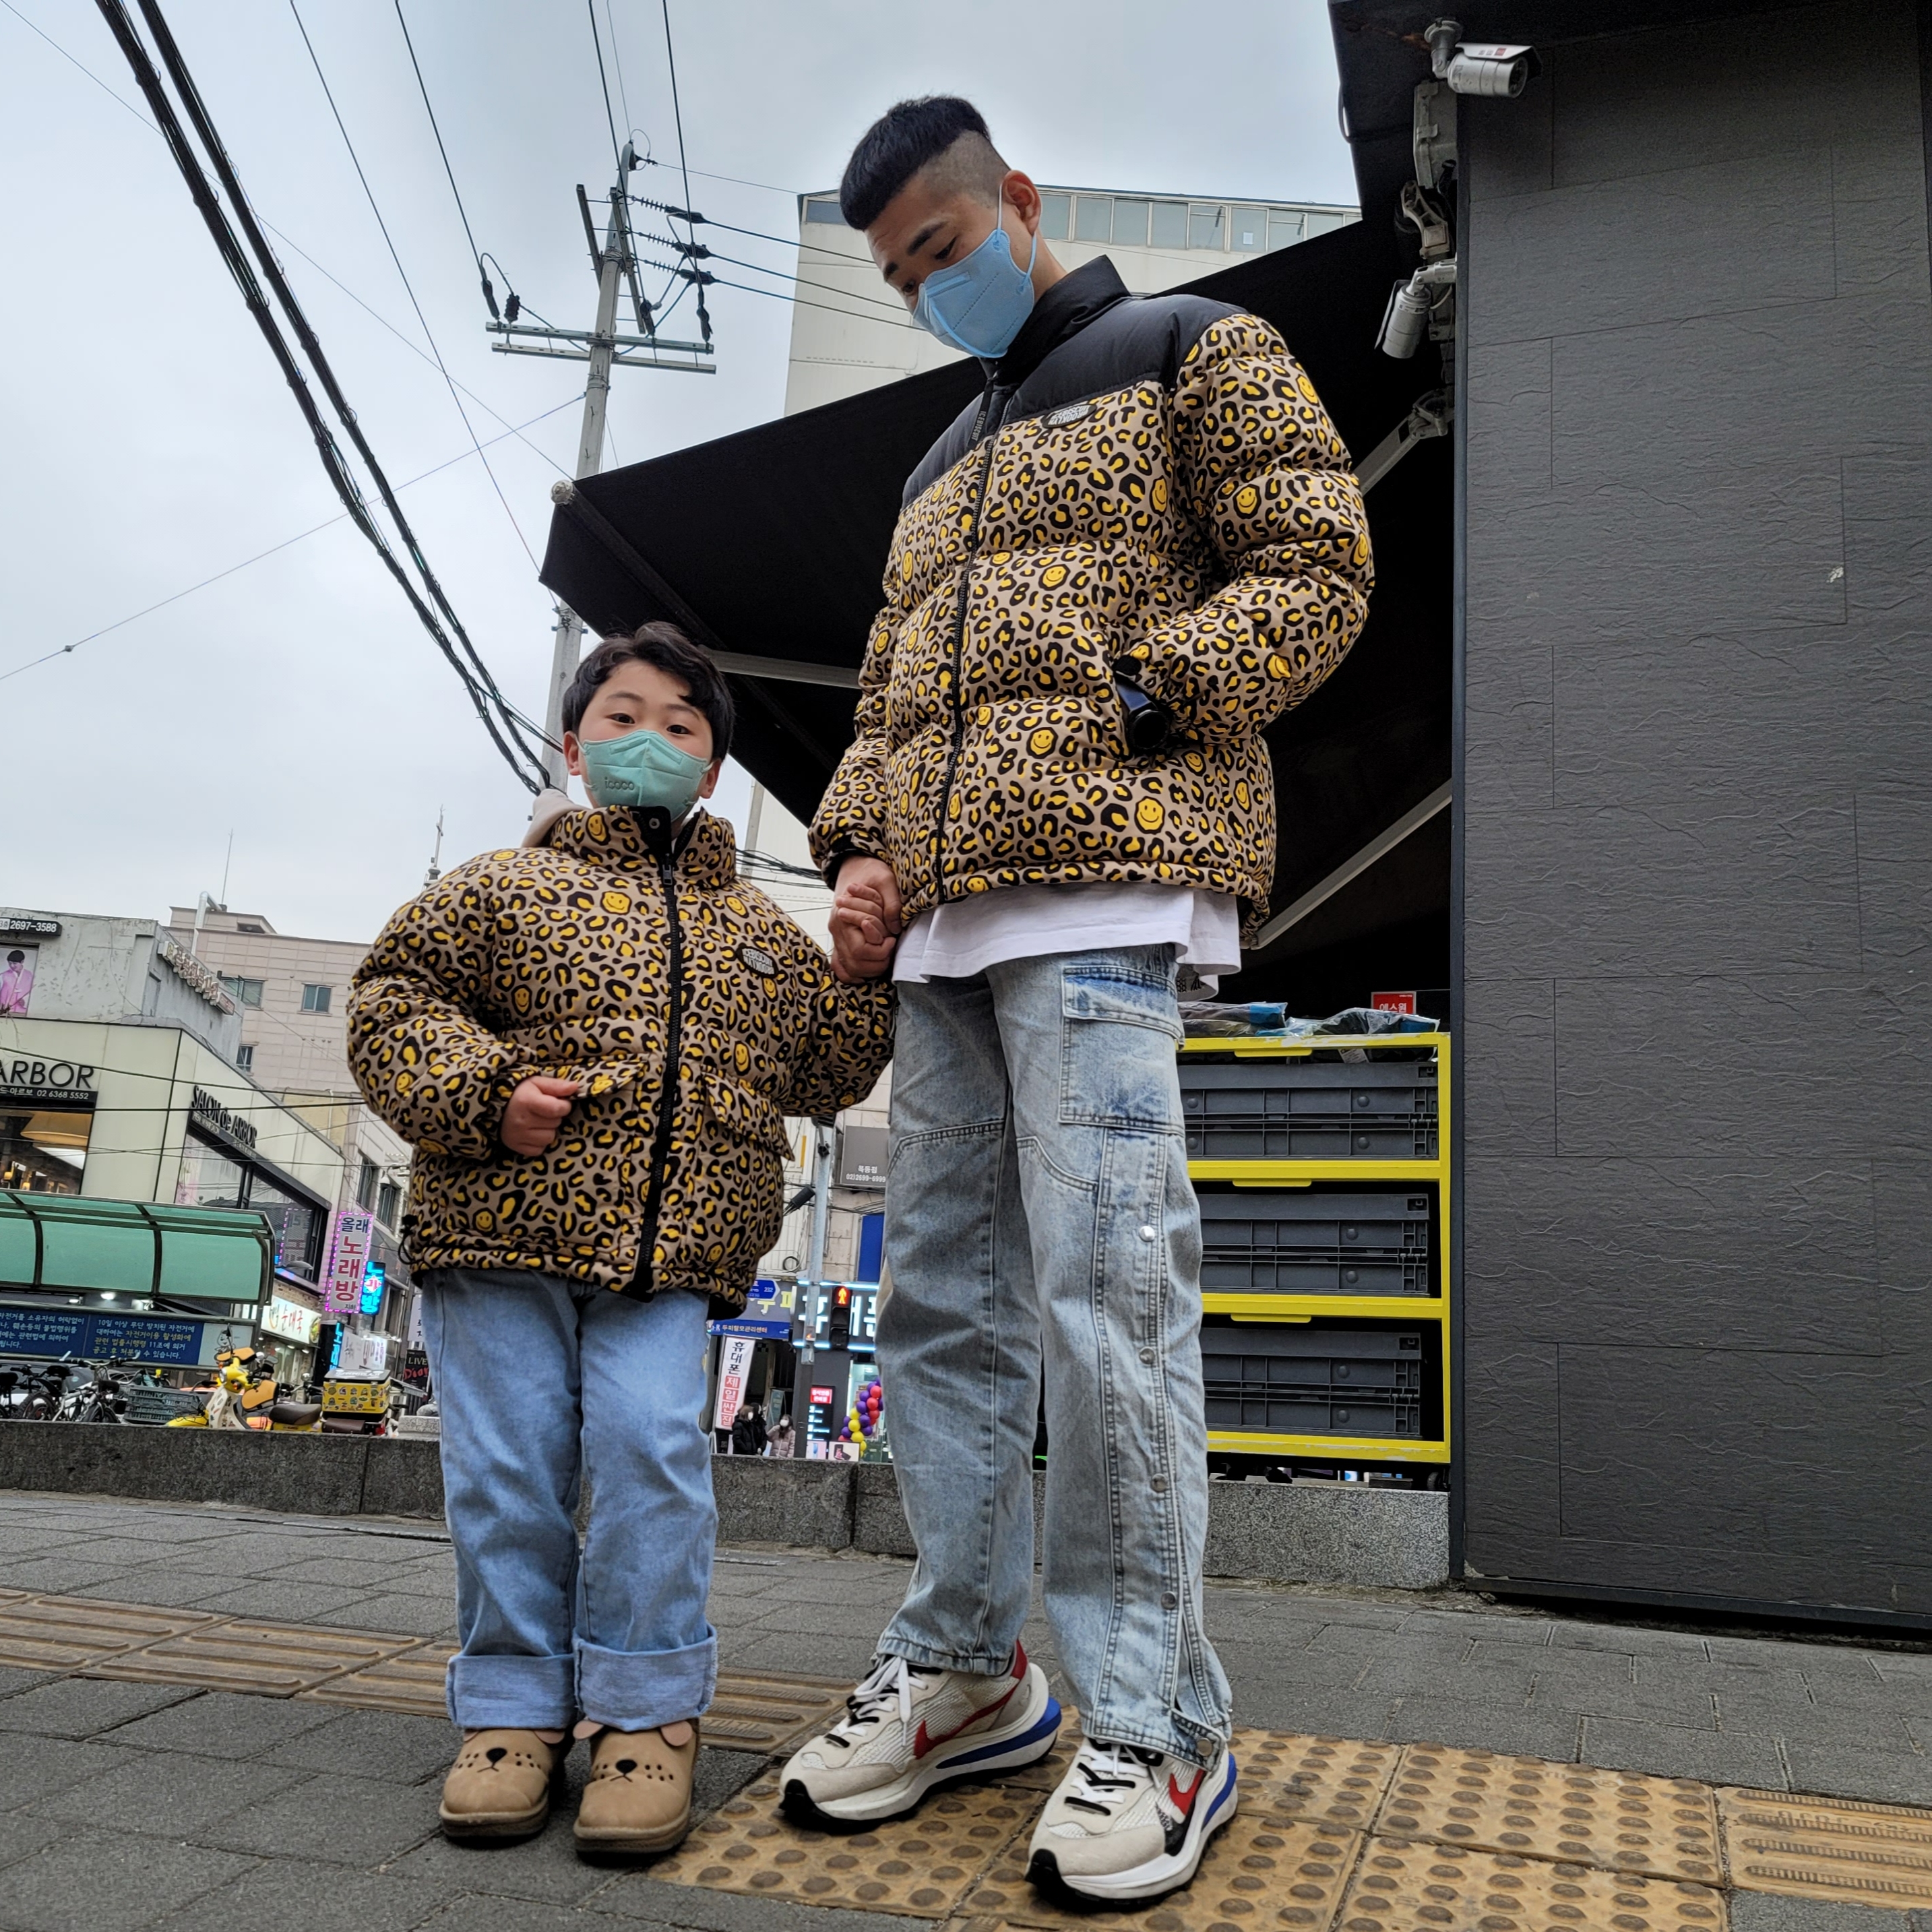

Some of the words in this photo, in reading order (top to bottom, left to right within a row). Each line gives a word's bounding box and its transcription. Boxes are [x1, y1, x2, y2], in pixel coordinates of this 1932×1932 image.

[10, 921, 57, 933] 2697-3588
[1379, 1003, 1407, 1014] 에스원
[9, 1088, 33, 1096] 아르보
[49, 1090, 67, 1098] 6368
[191, 1084, 221, 1123] SALON
[230, 1115, 257, 1149] ARBOR
[857, 1165, 877, 1174] 목동점
[846, 1173, 886, 1183] 02)2699-6999
[341, 1217, 369, 1234] 올래
[335, 1236, 363, 1302] 노래방
[27, 1315, 55, 1323] 소유자의
[58, 1316, 84, 1325] 허락없이
[43, 1324, 77, 1334] 불법행위를
[98, 1319, 113, 1328] 10일
[115, 1320, 127, 1328] 이상
[130, 1321, 144, 1330] 무단
[168, 1324, 195, 1333] 자전거에
[722, 1324, 768, 1334] 두피탈모관리센터
[0, 1330, 15, 1339] 에는
[48, 1334, 69, 1342] 의하여
[96, 1328, 123, 1337] 대하여는
[126, 1330, 160, 1340] 자전거이용
[163, 1332, 191, 1342] 활성화에
[112, 1339, 146, 1348] 법률시행령
[149, 1342, 170, 1350] 11조에
[152, 1351, 181, 1359] 있습니다.
[728, 1341, 745, 1375] 휴대폰
[722, 1377, 739, 1427] 제일싼집
